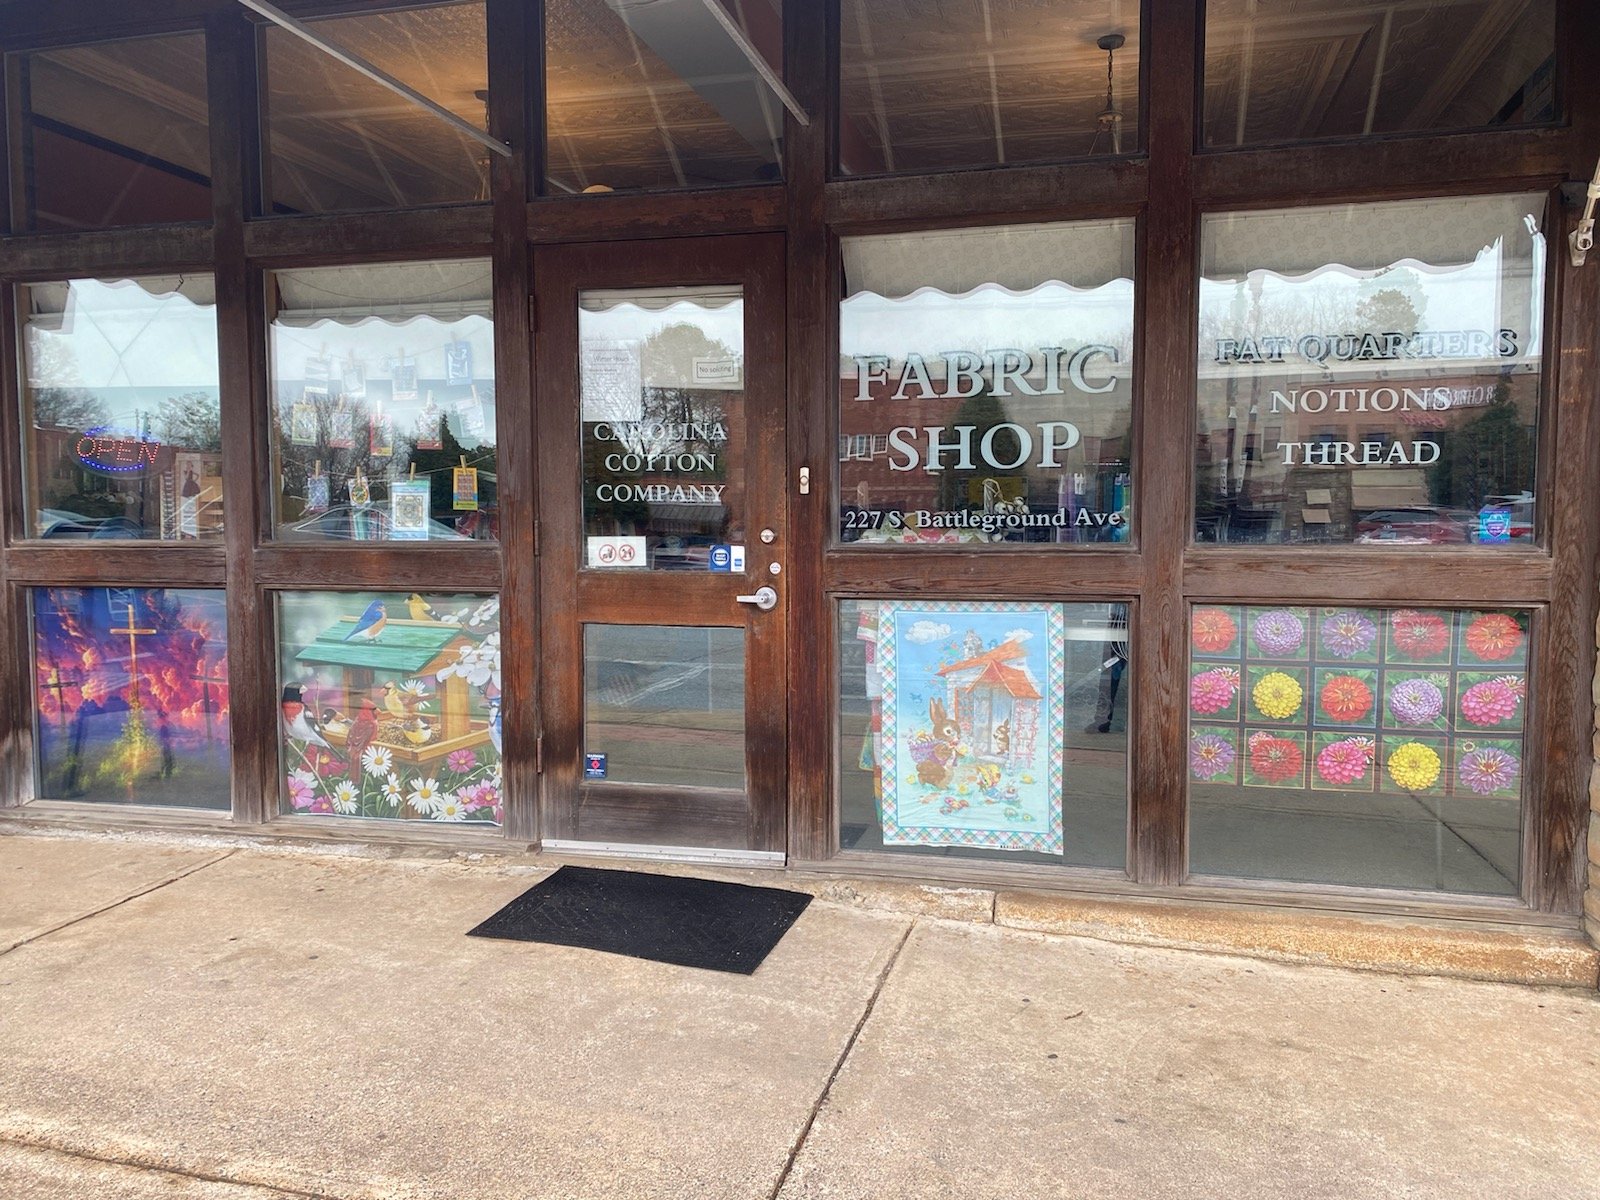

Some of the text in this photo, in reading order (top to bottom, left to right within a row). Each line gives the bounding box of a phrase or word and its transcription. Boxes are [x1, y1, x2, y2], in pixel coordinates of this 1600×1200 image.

[1214, 329, 1518, 369] FAT QUARTERS
[699, 366, 709, 374] No
[854, 345, 1119, 400] FABRIC
[1270, 387, 1451, 413] NOTIONS
[593, 423, 727, 442] CAROLINA
[77, 437, 160, 464] OPEN
[888, 422, 1080, 471] SHOP
[1277, 441, 1441, 465] THREAD
[605, 453, 716, 472] COTTON
[596, 483, 725, 503] COMPANY
[845, 511, 882, 528] 227
[916, 509, 1066, 533] Battleground
[1074, 507, 1121, 526] Ave
